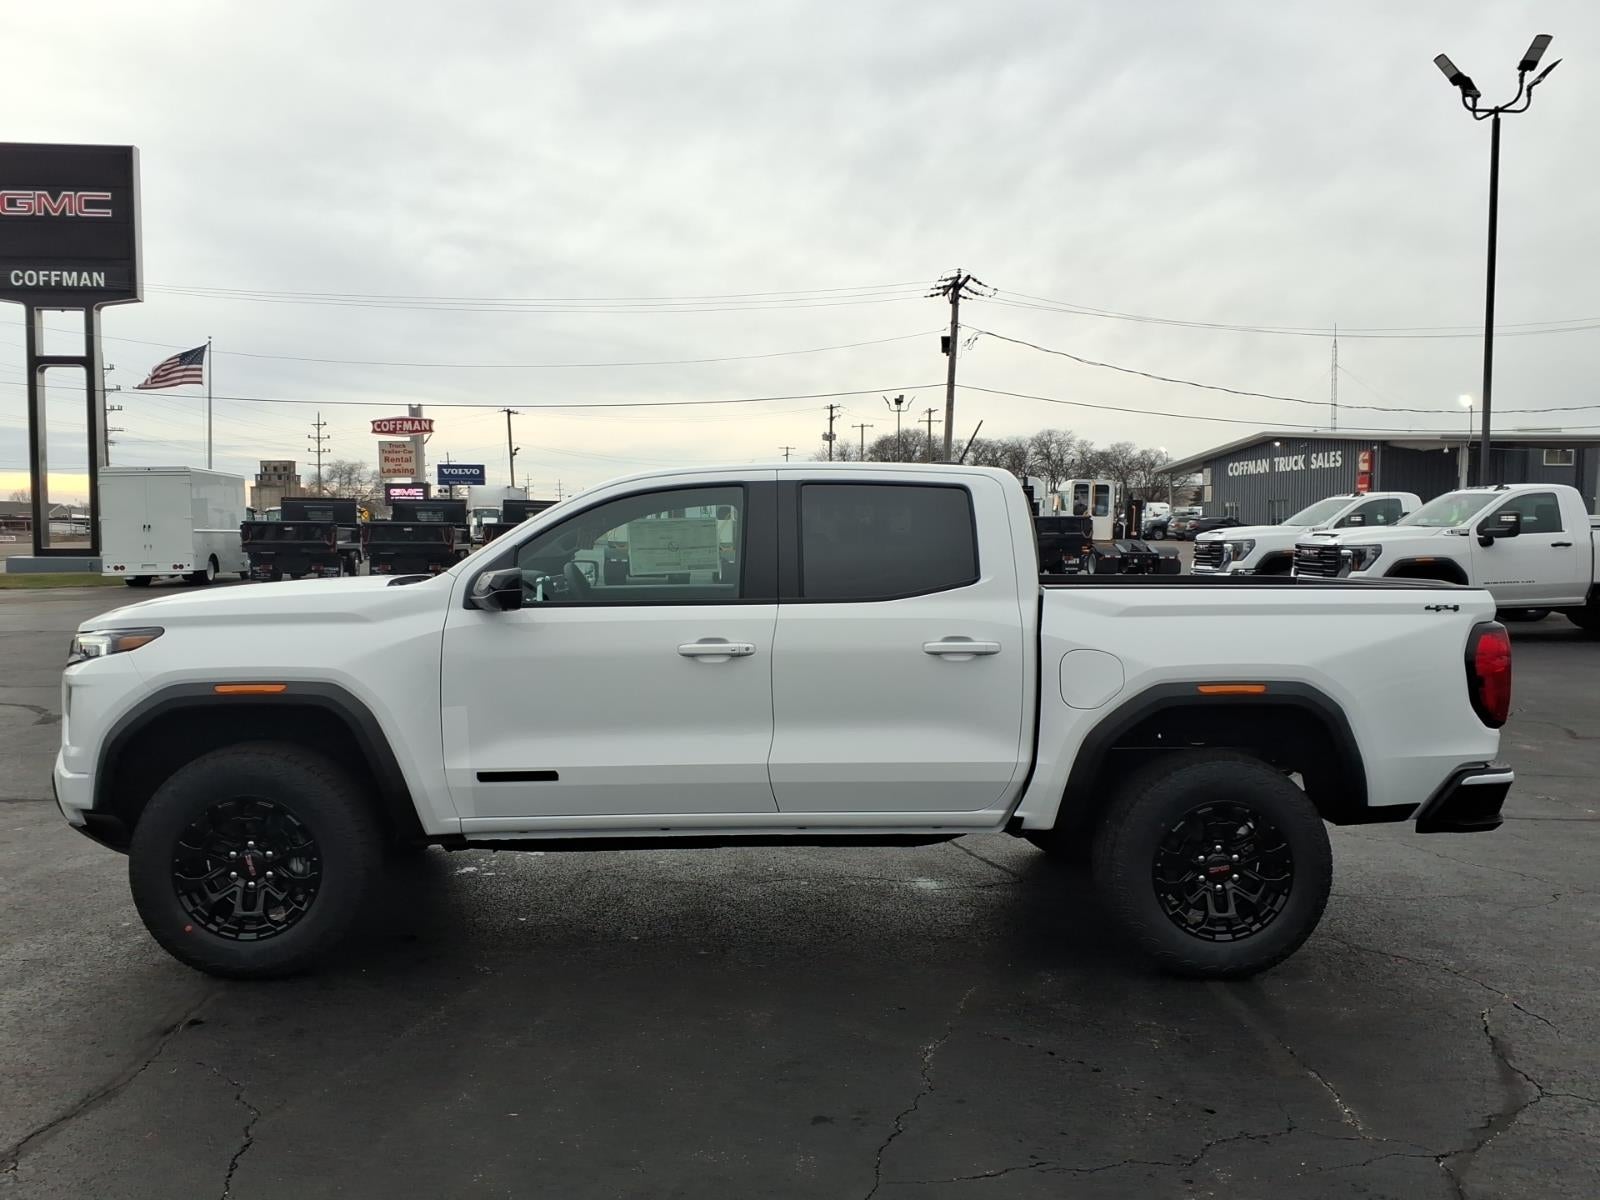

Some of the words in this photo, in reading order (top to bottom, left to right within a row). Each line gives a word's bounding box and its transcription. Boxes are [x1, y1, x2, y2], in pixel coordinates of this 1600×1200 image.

[0, 190, 112, 217] GMC
[10, 270, 105, 287] COFFMAN
[374, 420, 430, 431] COFFMAN
[382, 467, 415, 475] Leasing
[1228, 459, 1269, 476] COFFMAN
[1274, 454, 1306, 472] TRUCK
[1310, 451, 1342, 469] SALES
